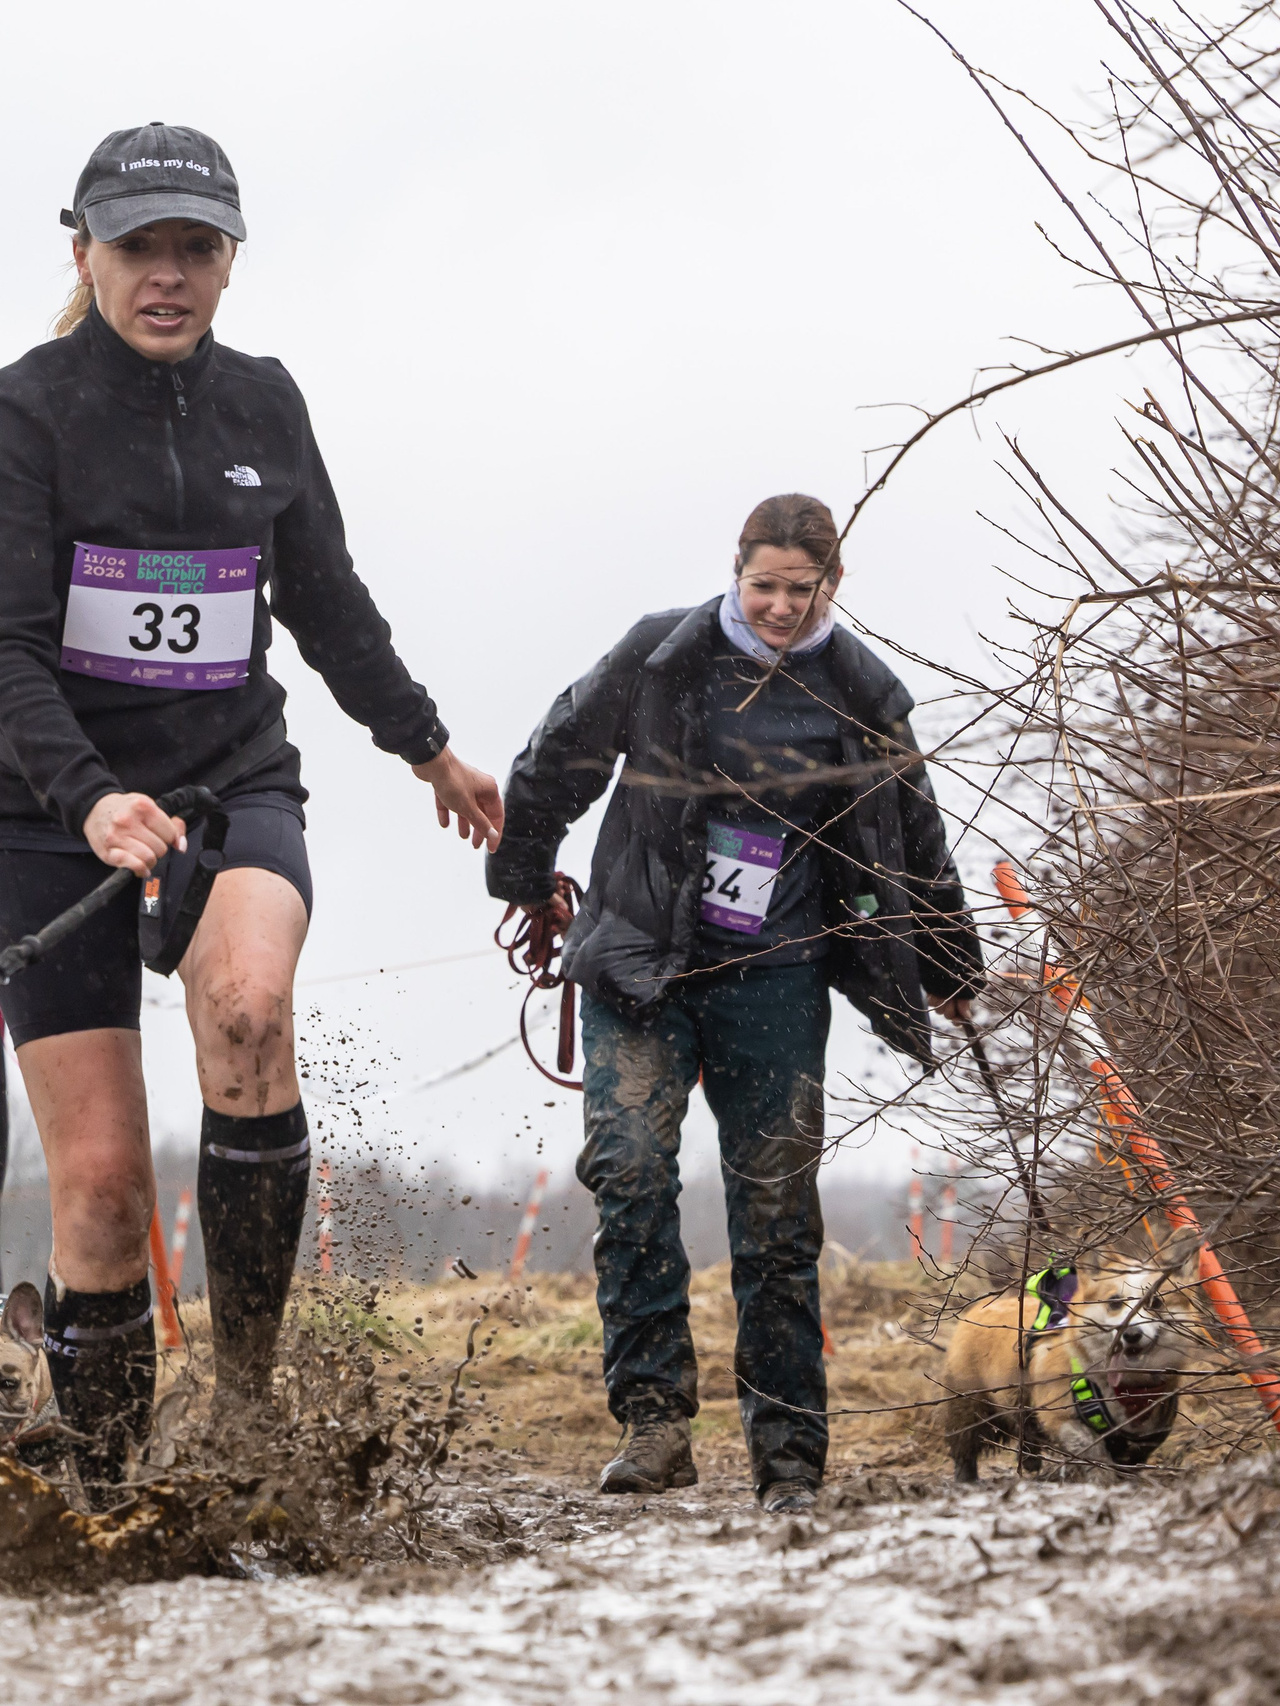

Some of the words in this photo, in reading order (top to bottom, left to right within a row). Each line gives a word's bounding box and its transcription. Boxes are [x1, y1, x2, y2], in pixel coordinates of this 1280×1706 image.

[121, 162, 126, 172] I
[128, 157, 161, 170] miss
[163, 159, 184, 169] my
[185, 160, 210, 176] dog
[83, 553, 127, 567] 11/04
[83, 564, 125, 579] 2026
[218, 568, 226, 579] 2
[128, 602, 201, 654] 33
